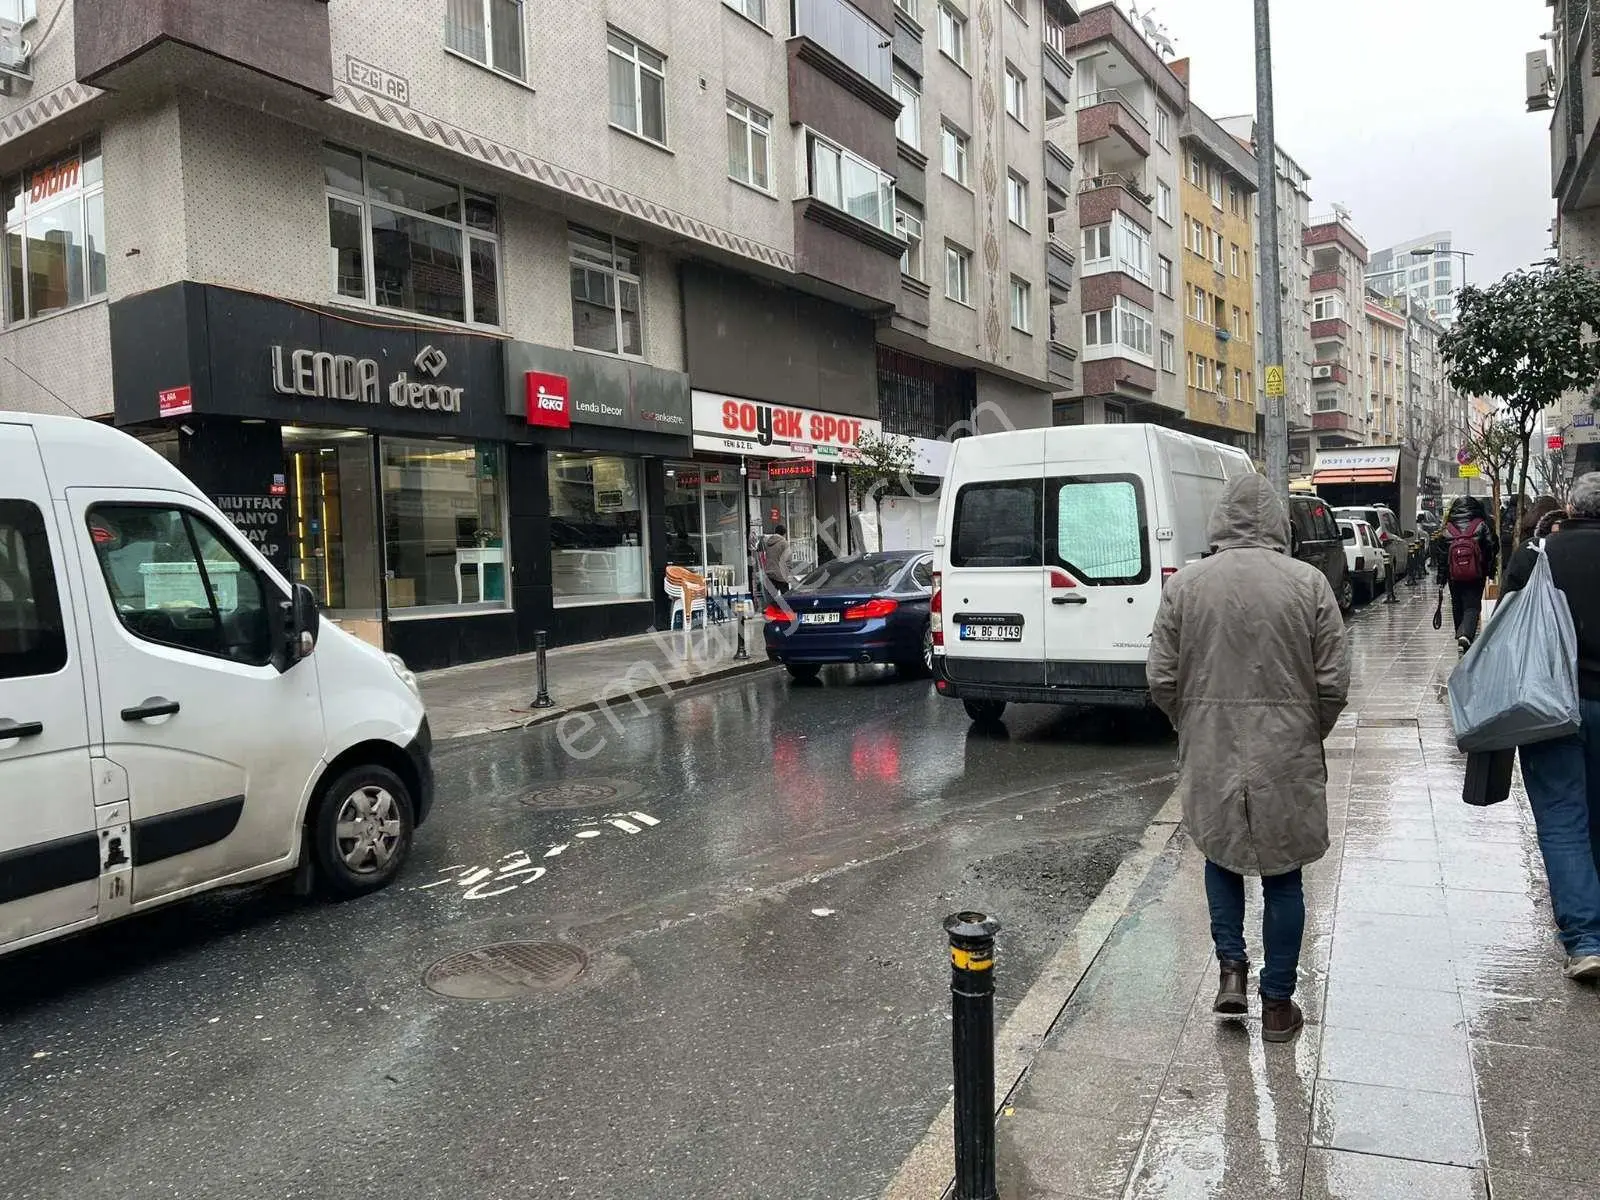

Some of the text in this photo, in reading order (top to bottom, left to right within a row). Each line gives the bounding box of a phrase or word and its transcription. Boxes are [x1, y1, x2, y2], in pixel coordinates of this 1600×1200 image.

[272, 345, 464, 413] LENDA decor
[575, 401, 623, 417] Lenda Decor
[810, 414, 863, 446] SPOT
[217, 496, 283, 510] MUTFAK
[965, 625, 1020, 638] 34 BG 0149
